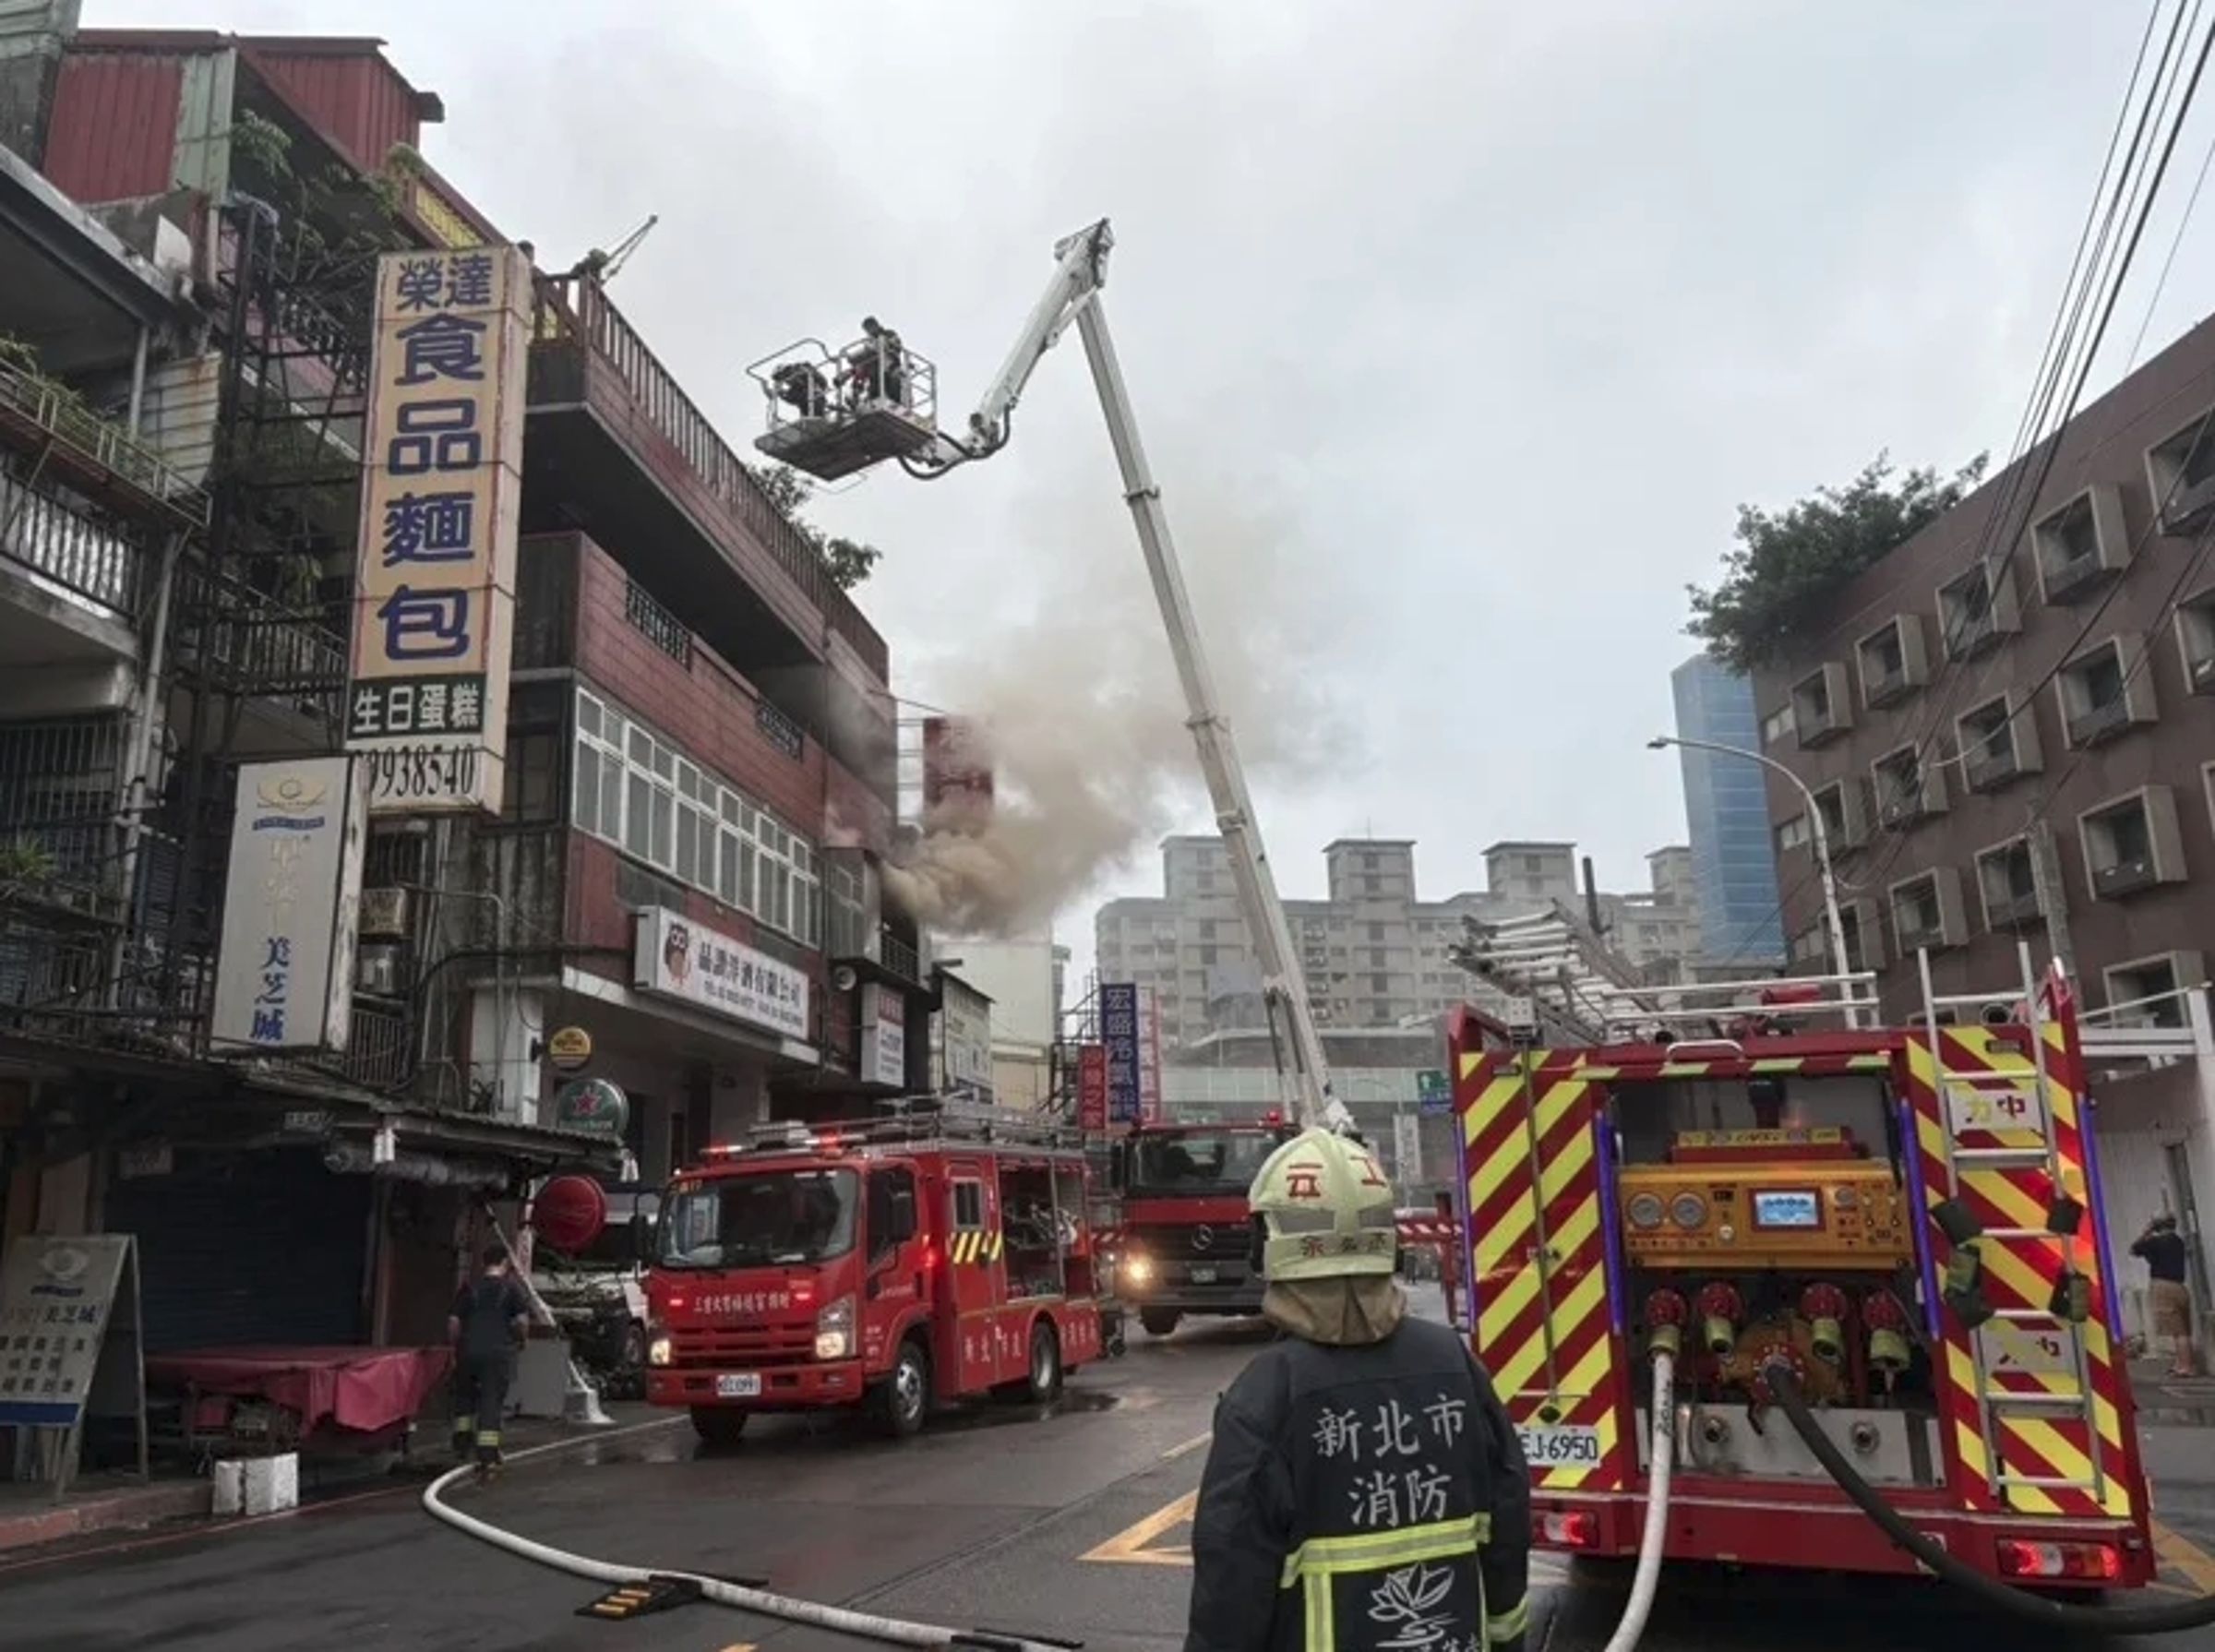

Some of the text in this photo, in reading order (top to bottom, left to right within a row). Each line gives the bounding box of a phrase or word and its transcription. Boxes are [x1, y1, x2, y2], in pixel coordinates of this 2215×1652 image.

[396, 256, 493, 311] 榮達
[377, 313, 486, 661] 食品麵包
[353, 684, 480, 735] 生日蛋糕
[249, 936, 291, 1042] 美芝城
[1312, 1394, 1467, 1461] 新北市
[1348, 1465, 1452, 1526] 消防
